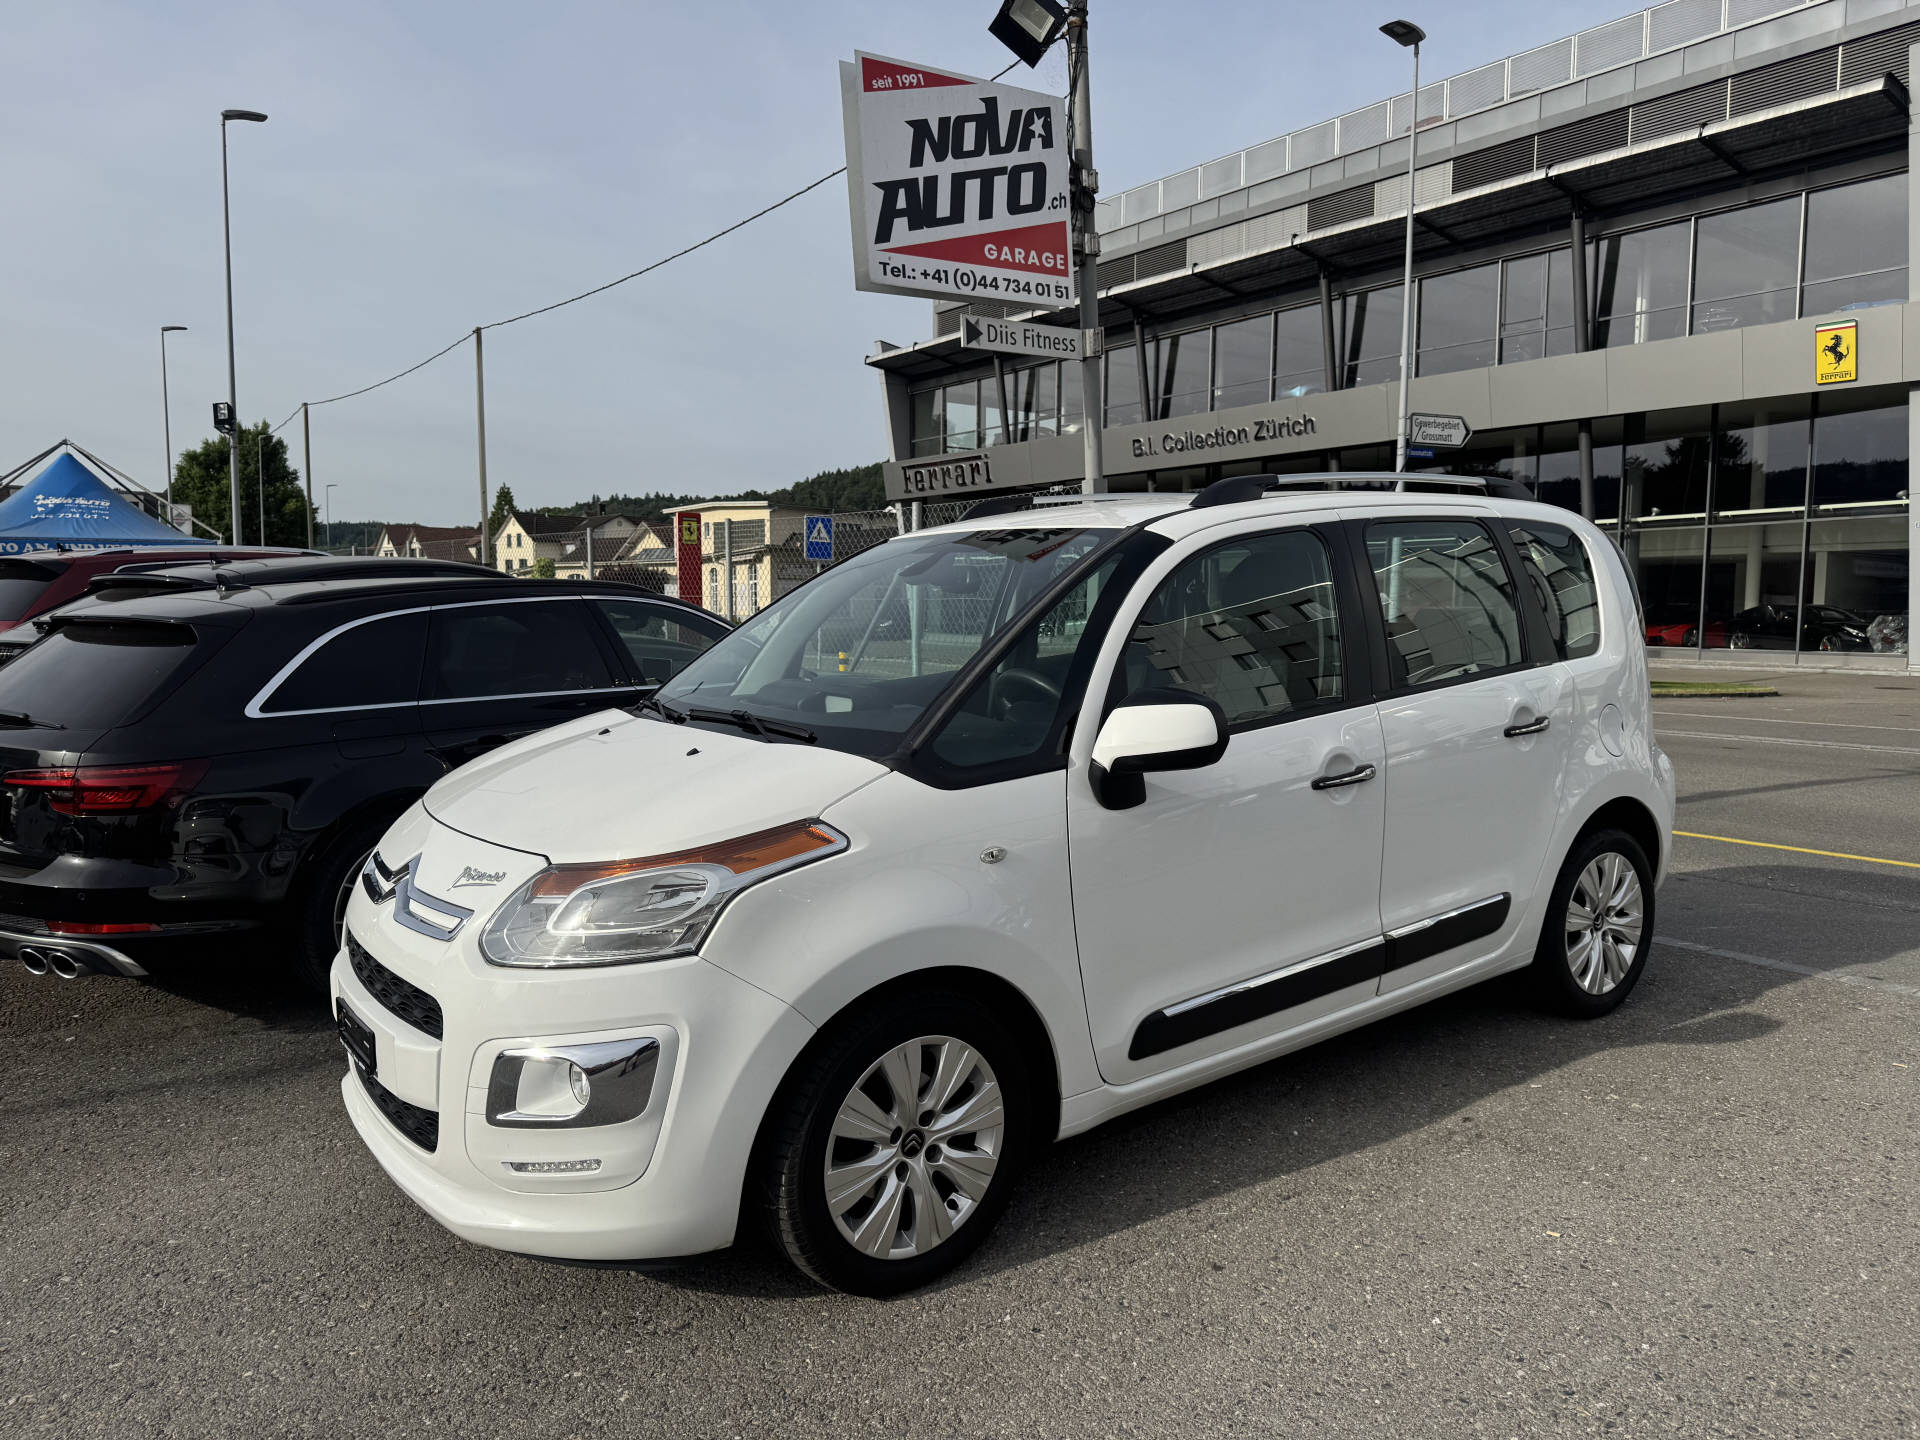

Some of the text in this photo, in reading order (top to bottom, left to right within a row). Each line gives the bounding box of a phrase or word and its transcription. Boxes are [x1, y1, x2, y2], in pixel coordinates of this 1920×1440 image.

[872, 73, 925, 89] seit 1991
[904, 95, 1054, 168] NOVA
[984, 243, 1065, 270] GARAGE
[879, 261, 917, 280] Tel.:
[920, 268, 949, 285] +41
[1003, 278, 1032, 294] 734
[1035, 282, 1051, 297] 01
[1054, 285, 1070, 300] 51
[987, 324, 1076, 353] Diis Fitness
[1820, 370, 1852, 381] Ferrari
[1162, 426, 1250, 454] Collection
[1253, 413, 1317, 442] Zürich
[1414, 418, 1460, 431] Gewerbegebiet
[1421, 431, 1453, 443] Grossmatt
[901, 453, 993, 494] Ferrari
